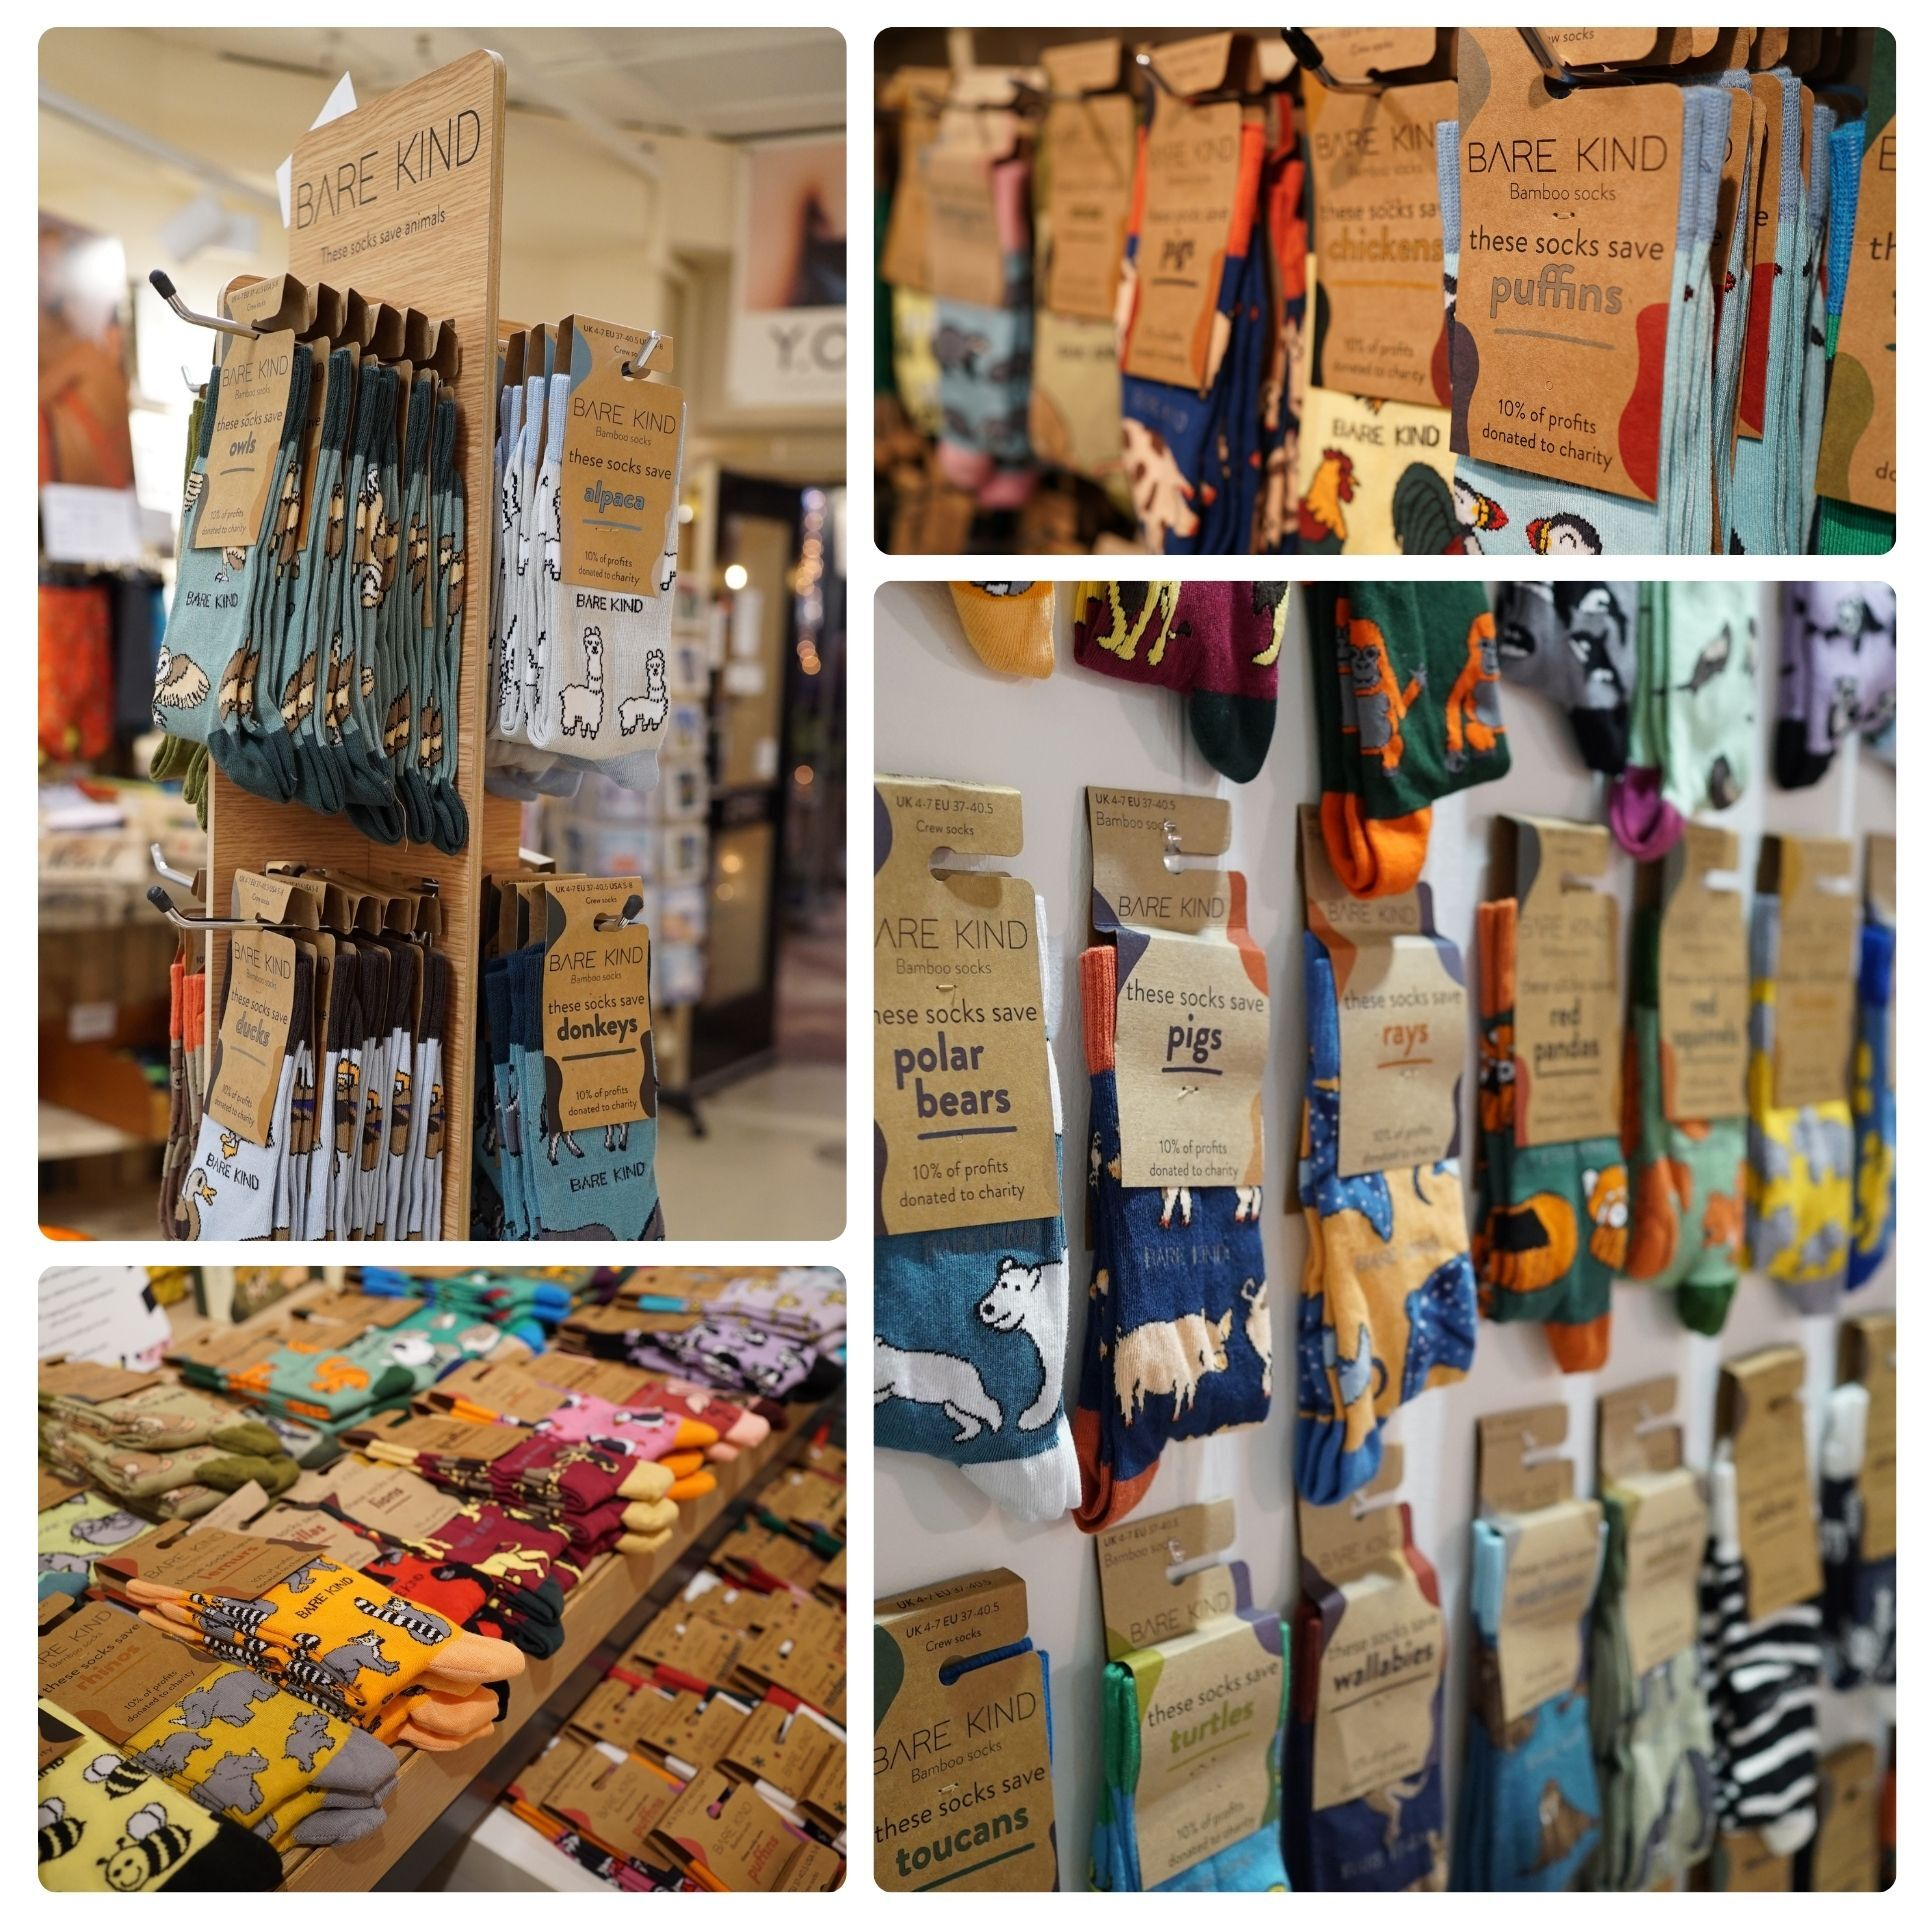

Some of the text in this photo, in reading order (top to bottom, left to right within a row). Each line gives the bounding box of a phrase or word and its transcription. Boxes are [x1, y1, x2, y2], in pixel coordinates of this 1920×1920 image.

[1563, 27, 1596, 43] socks
[1391, 121, 1435, 152] KIN
[297, 110, 480, 229] BARE KIND
[1468, 135, 1668, 173] BARE KIND
[1510, 183, 1616, 201] Bamboo socks
[1370, 199, 1414, 219] socks
[321, 204, 446, 265] These socks save animals
[1328, 225, 1443, 264] chickens
[1469, 224, 1664, 261] these socks save
[1490, 263, 1624, 320] puffins
[583, 324, 615, 339] UK EU
[614, 345, 630, 357] Crew
[222, 355, 289, 387] BARE KIND
[217, 411, 283, 432] these socks save
[573, 397, 676, 435] BARE KIND
[1498, 399, 1597, 435] 10% of profits
[229, 430, 257, 457] owls
[595, 426, 652, 447] Bamboo socks
[1332, 419, 1441, 448] BARE KIND
[1482, 422, 1613, 473] donated to charity
[569, 448, 672, 480] these socks save
[584, 480, 645, 514] alpaca
[584, 551, 633, 568] 10% profits
[578, 566, 640, 588] donated charity
[186, 591, 239, 609] BARE KIND
[576, 593, 643, 614] BARE KIND
[896, 796, 994, 815] UK 4-7 EU 37-40.5
[1095, 794, 1176, 811] UK 4-7 EU 37-40.5
[916, 820, 975, 836] Crew socks
[1096, 811, 1144, 829] Bamboo
[586, 897, 600, 905] Crew
[609, 883, 622, 891] USA
[1118, 896, 1225, 919] BARE KIND
[874, 917, 1028, 950] ARE KIND
[234, 941, 261, 969] BARE
[265, 954, 291, 980] KIND
[550, 946, 644, 972] BARE KIND
[896, 958, 993, 975] Bamboo socks
[570, 971, 621, 984] Bamboo socks
[231, 989, 288, 1024] these socks save
[548, 994, 645, 1015] these socks save
[926, 998, 1038, 1024] socks save
[1126, 978, 1265, 1013] these socks save
[1344, 985, 1430, 1011] these socks
[1549, 996, 1581, 1027] red
[235, 1011, 270, 1047] ducks
[557, 1013, 638, 1044] donkeys
[1166, 1013, 1222, 1064] pigs
[1381, 1022, 1430, 1057] rays
[894, 1031, 985, 1090] polar
[1534, 1030, 1601, 1066] pandas
[568, 1100, 638, 1117] donated charity
[576, 1085, 628, 1101] 10% profits
[915, 1077, 1011, 1119] bears
[1159, 1139, 1228, 1159] 10% profits
[206, 1152, 259, 1191] BARE KIND
[570, 1161, 645, 1193] BARE KIND
[913, 1158, 1009, 1182] 10% of profits
[1150, 1162, 1239, 1181] donated to charity
[899, 1182, 1026, 1208] donated to charity
[143, 1553, 189, 1579] BARE
[198, 1546, 259, 1580] lemurs
[294, 1576, 355, 1619] BARE KIND
[68, 1610, 112, 1642] KIND
[905, 1602, 1001, 1639] UK 4-7 EU 37-40.5
[1129, 1608, 1180, 1644] BARE
[926, 1628, 982, 1652] Crew socks
[42, 1623, 142, 1694] these socks save
[76, 1643, 141, 1692] rhinos
[1333, 1642, 1435, 1692] wallabies
[123, 1670, 178, 1711] 10% profits
[127, 1669, 196, 1723] donated charity
[1147, 1674, 1241, 1728] these socks
[874, 1692, 1037, 1776] BARE KIND
[1170, 1700, 1254, 1753] turtles
[911, 1740, 1002, 1784] Bamboo socks
[874, 1767, 1046, 1844] these socks save
[896, 1806, 1029, 1877] toucans
[746, 1835, 780, 1884] puffins
